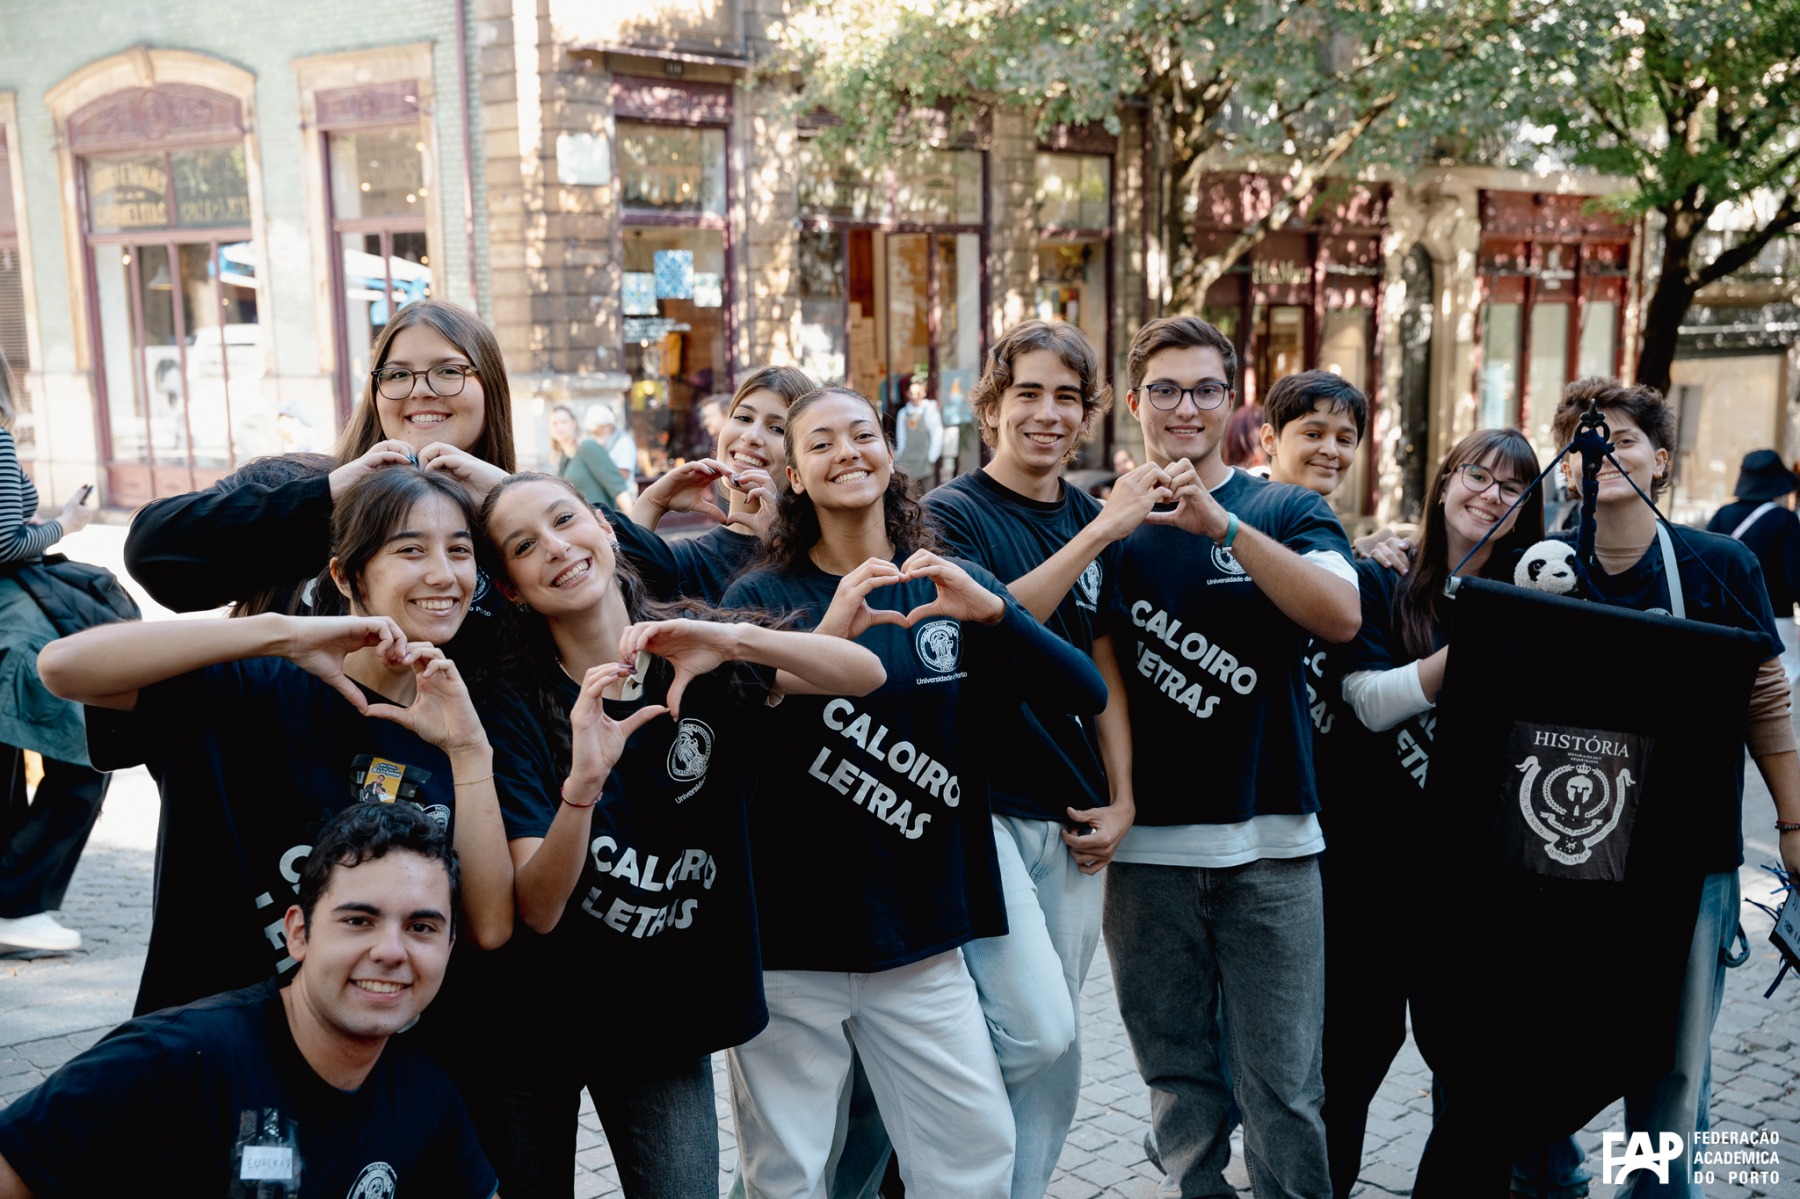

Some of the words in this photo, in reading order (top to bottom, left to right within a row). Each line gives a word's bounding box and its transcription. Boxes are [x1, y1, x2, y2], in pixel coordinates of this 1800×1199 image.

[1206, 575, 1244, 586] Universidade
[1131, 600, 1257, 695] CALOIRO
[823, 698, 961, 808] CALOIRO
[1533, 730, 1630, 758] HISTÓRIA
[807, 746, 932, 840] LETRAS
